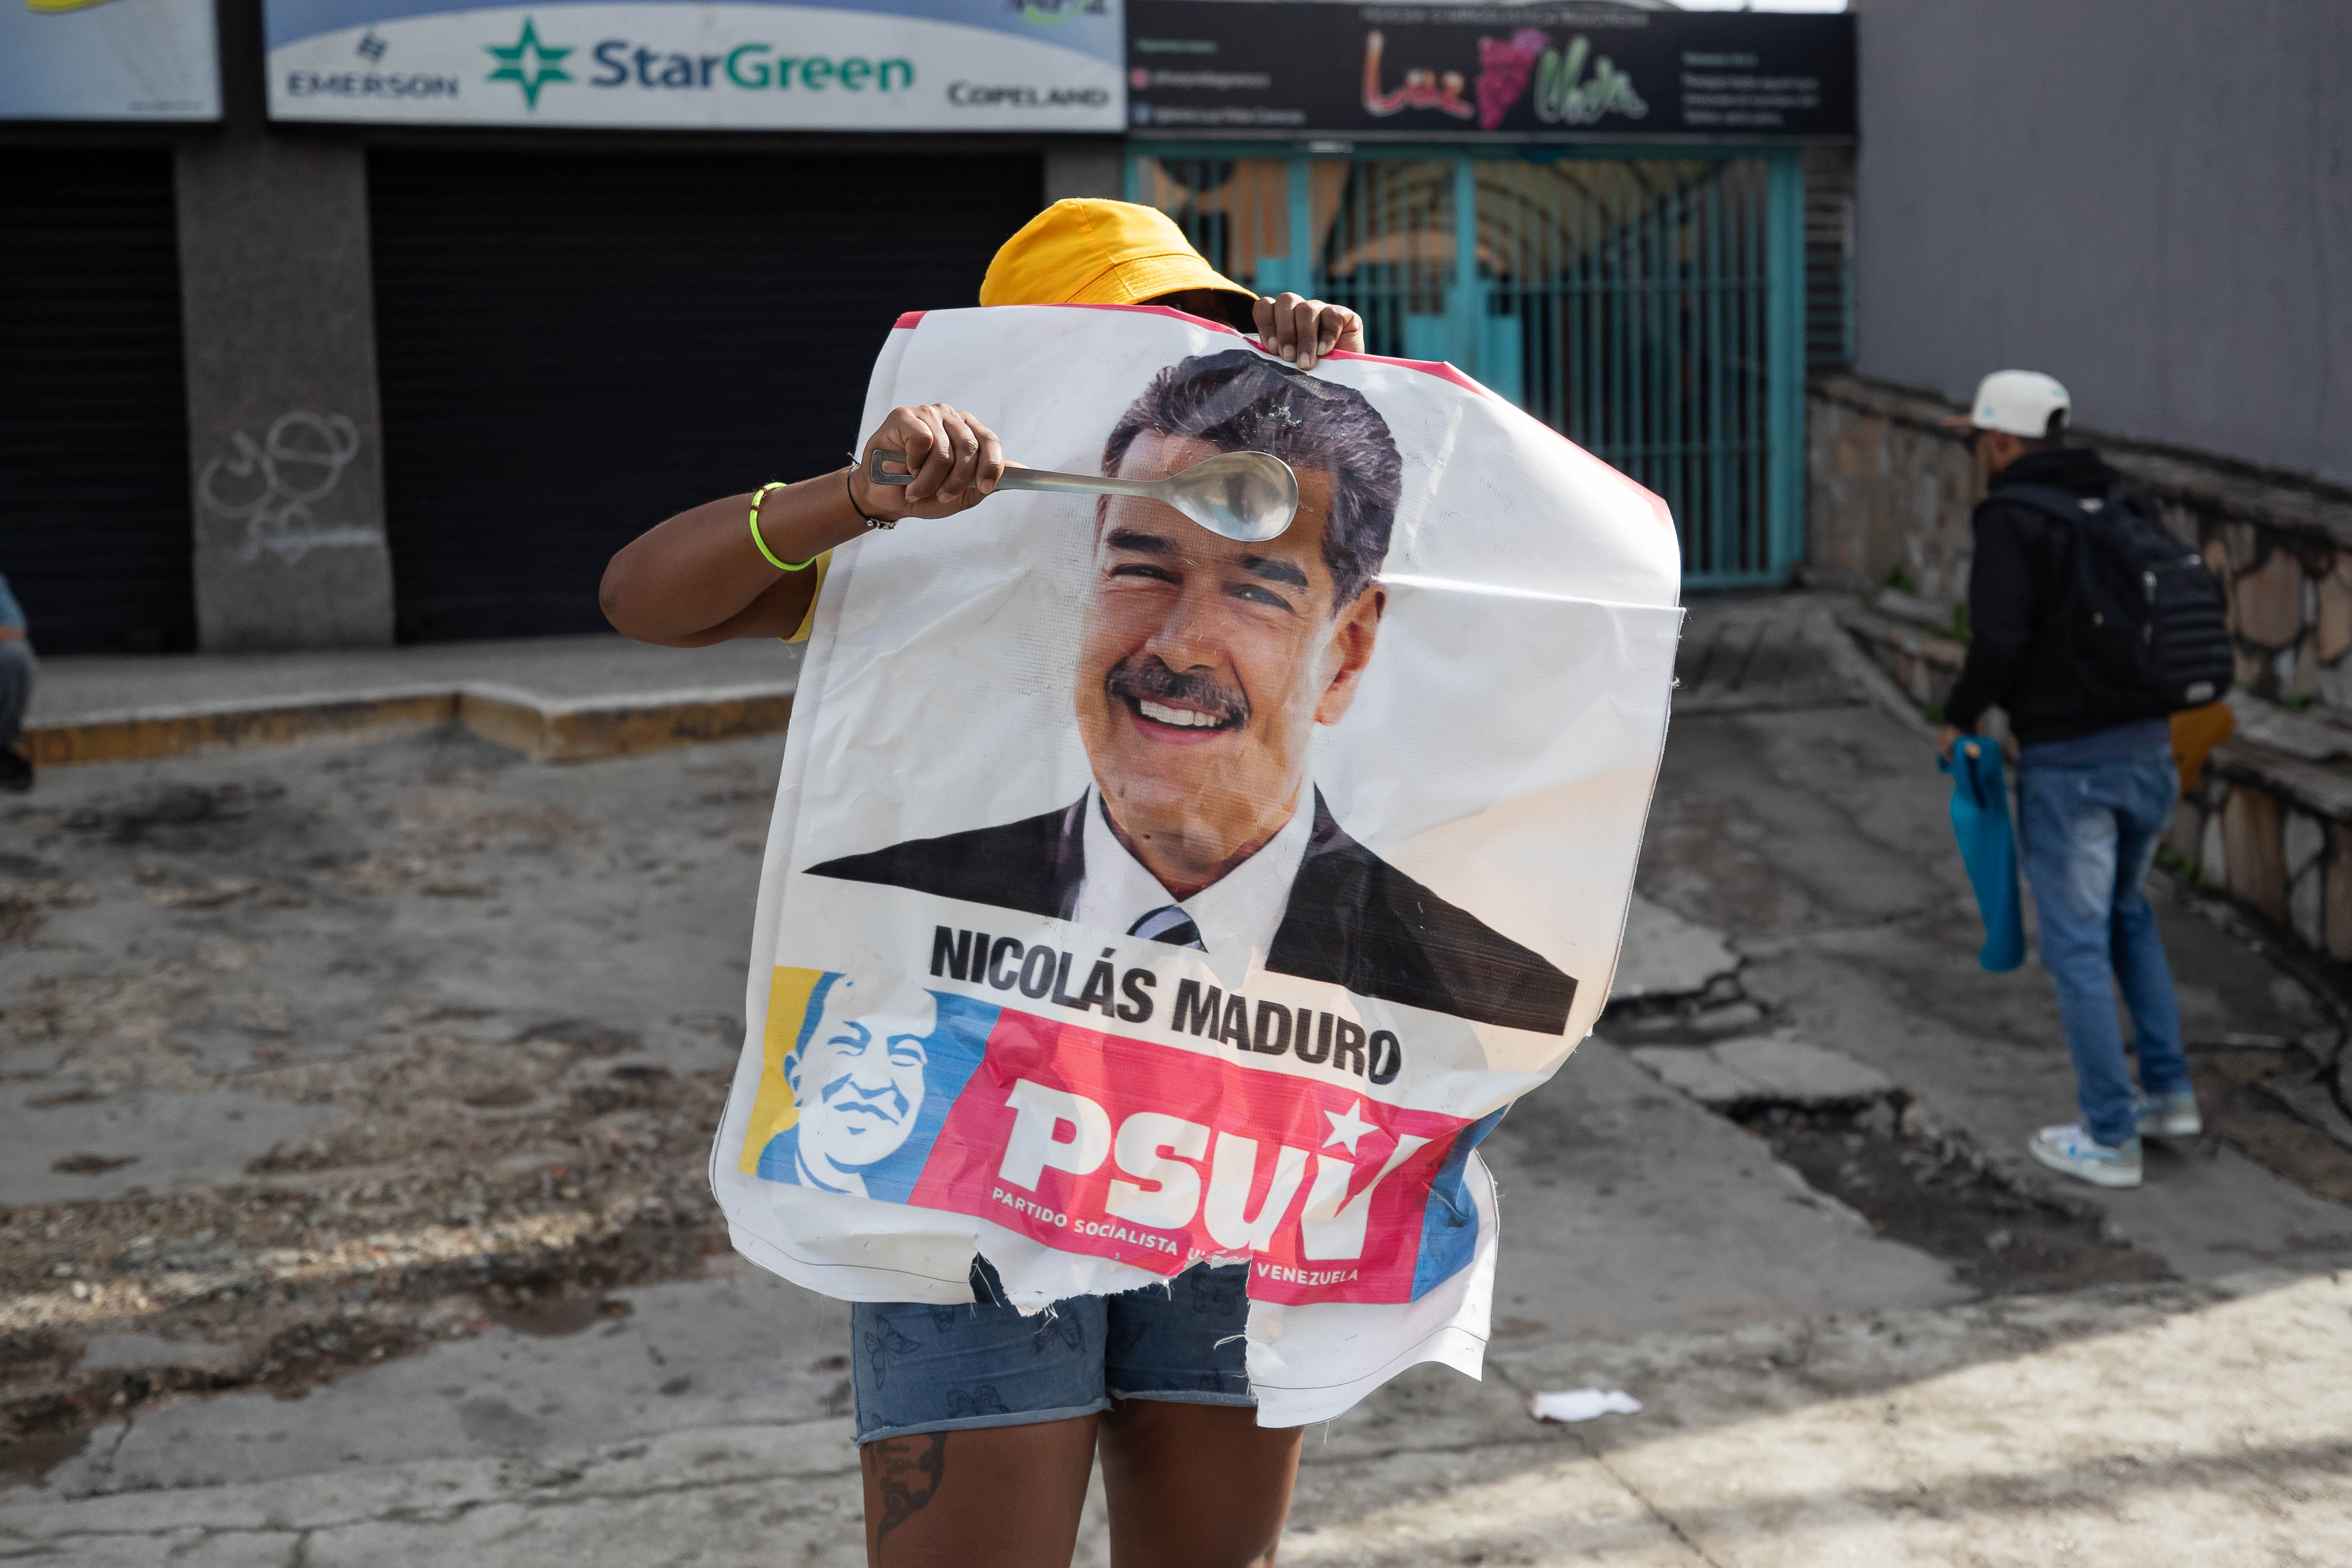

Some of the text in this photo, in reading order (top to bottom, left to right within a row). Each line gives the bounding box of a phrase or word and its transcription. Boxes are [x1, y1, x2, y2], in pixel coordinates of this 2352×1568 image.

[287, 72, 460, 100] EMERSON
[589, 40, 916, 92] StarGreen
[930, 924, 1402, 1085] NICOLÁS MADURO
[997, 1077, 1433, 1261] PSUV
[992, 1186, 1068, 1228] PARTIDO
[1074, 1219, 1177, 1256] SOCIALISTA
[1257, 1262, 1359, 1286] VENEZUELA
